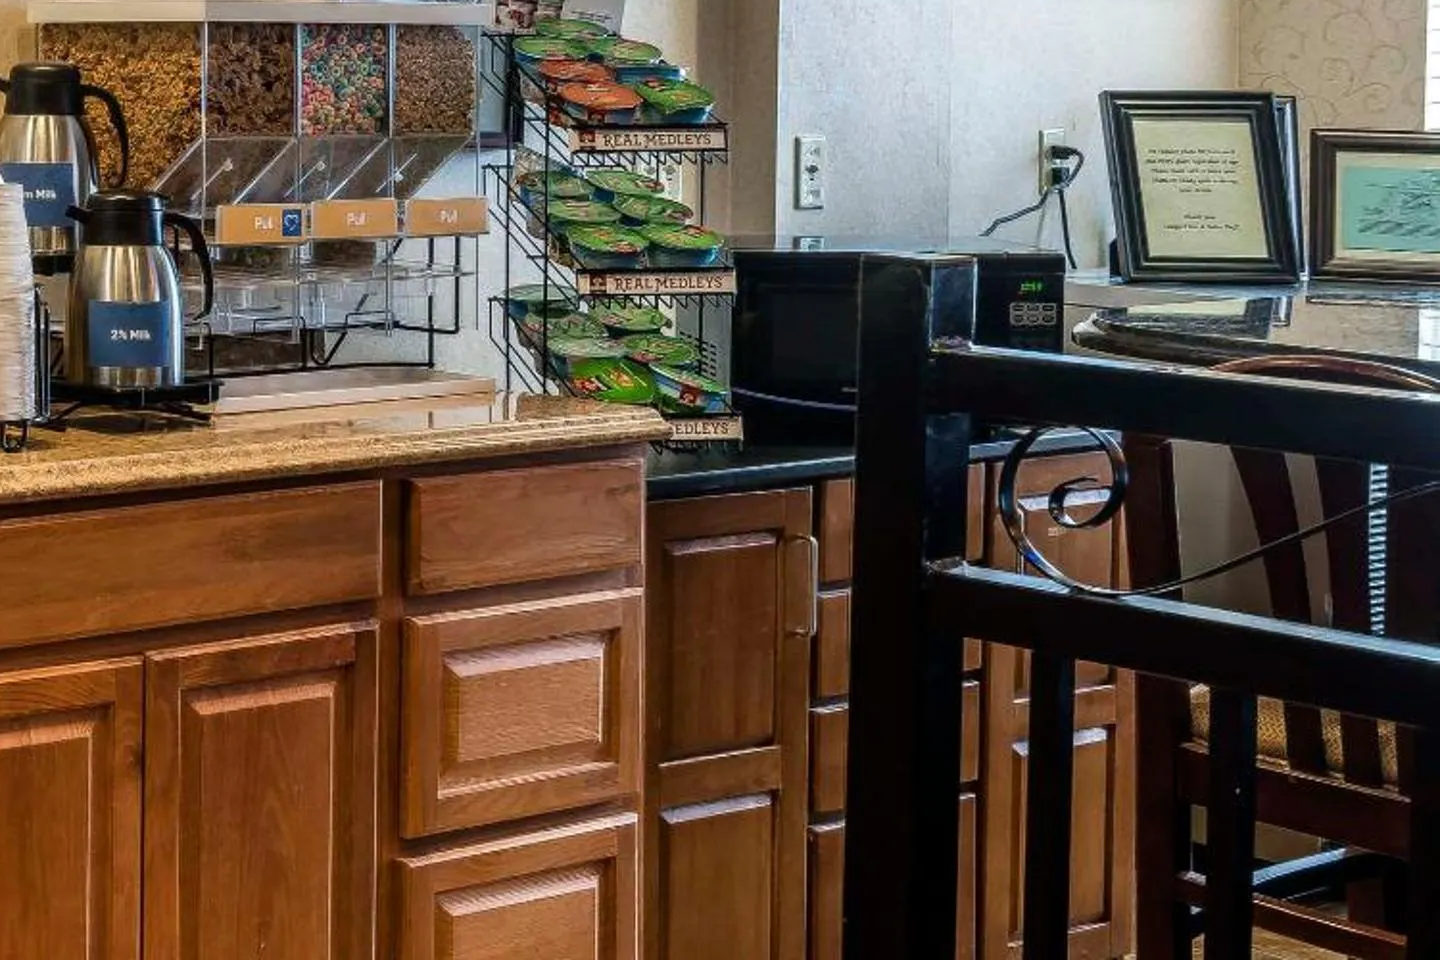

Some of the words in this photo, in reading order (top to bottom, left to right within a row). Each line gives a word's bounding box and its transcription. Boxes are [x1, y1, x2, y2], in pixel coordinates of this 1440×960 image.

[603, 134, 643, 149] REAL
[644, 132, 712, 149] MEDLEYS
[35, 189, 57, 199] Milk
[614, 276, 654, 292] REAL
[655, 275, 723, 292] MEDLEYS
[110, 329, 127, 341] 2%
[129, 329, 152, 341] Milk
[674, 422, 729, 435] EDLEYS
